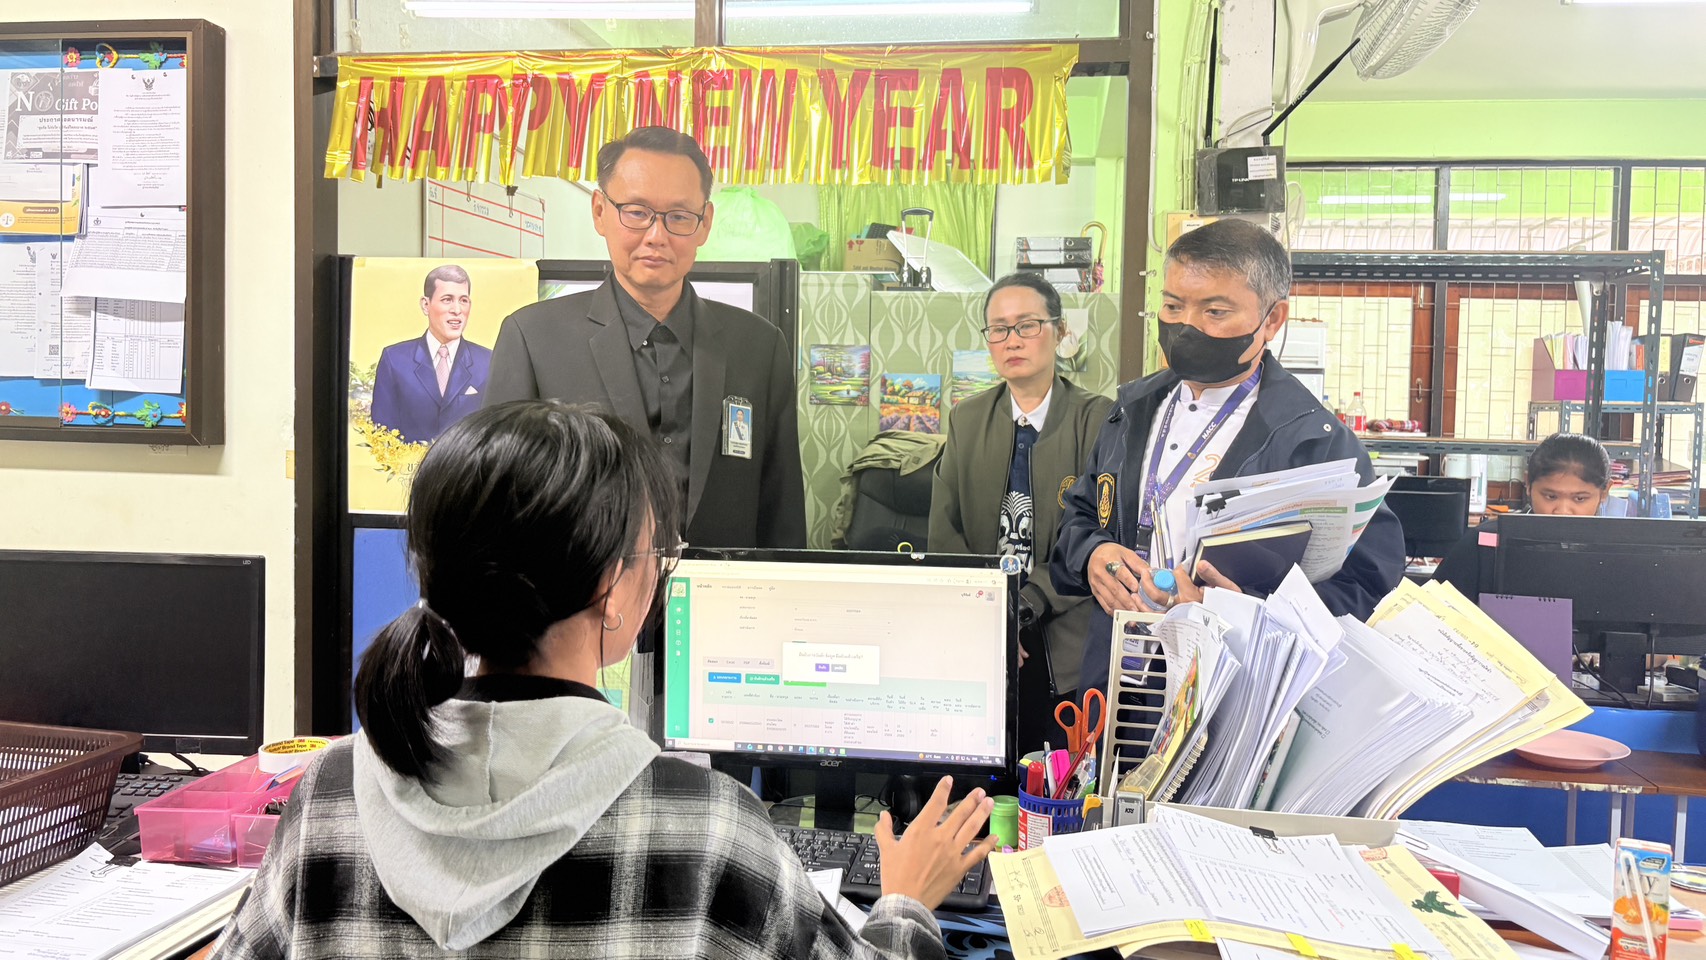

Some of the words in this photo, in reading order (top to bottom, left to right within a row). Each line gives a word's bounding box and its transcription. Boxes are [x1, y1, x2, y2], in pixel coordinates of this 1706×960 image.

[55, 98, 79, 111] Gift
[351, 72, 609, 170] HAPPY
[634, 68, 798, 171] NEW
[816, 67, 1034, 171] YEAR
[1202, 421, 1217, 440] NACC
[820, 759, 842, 767] acer
